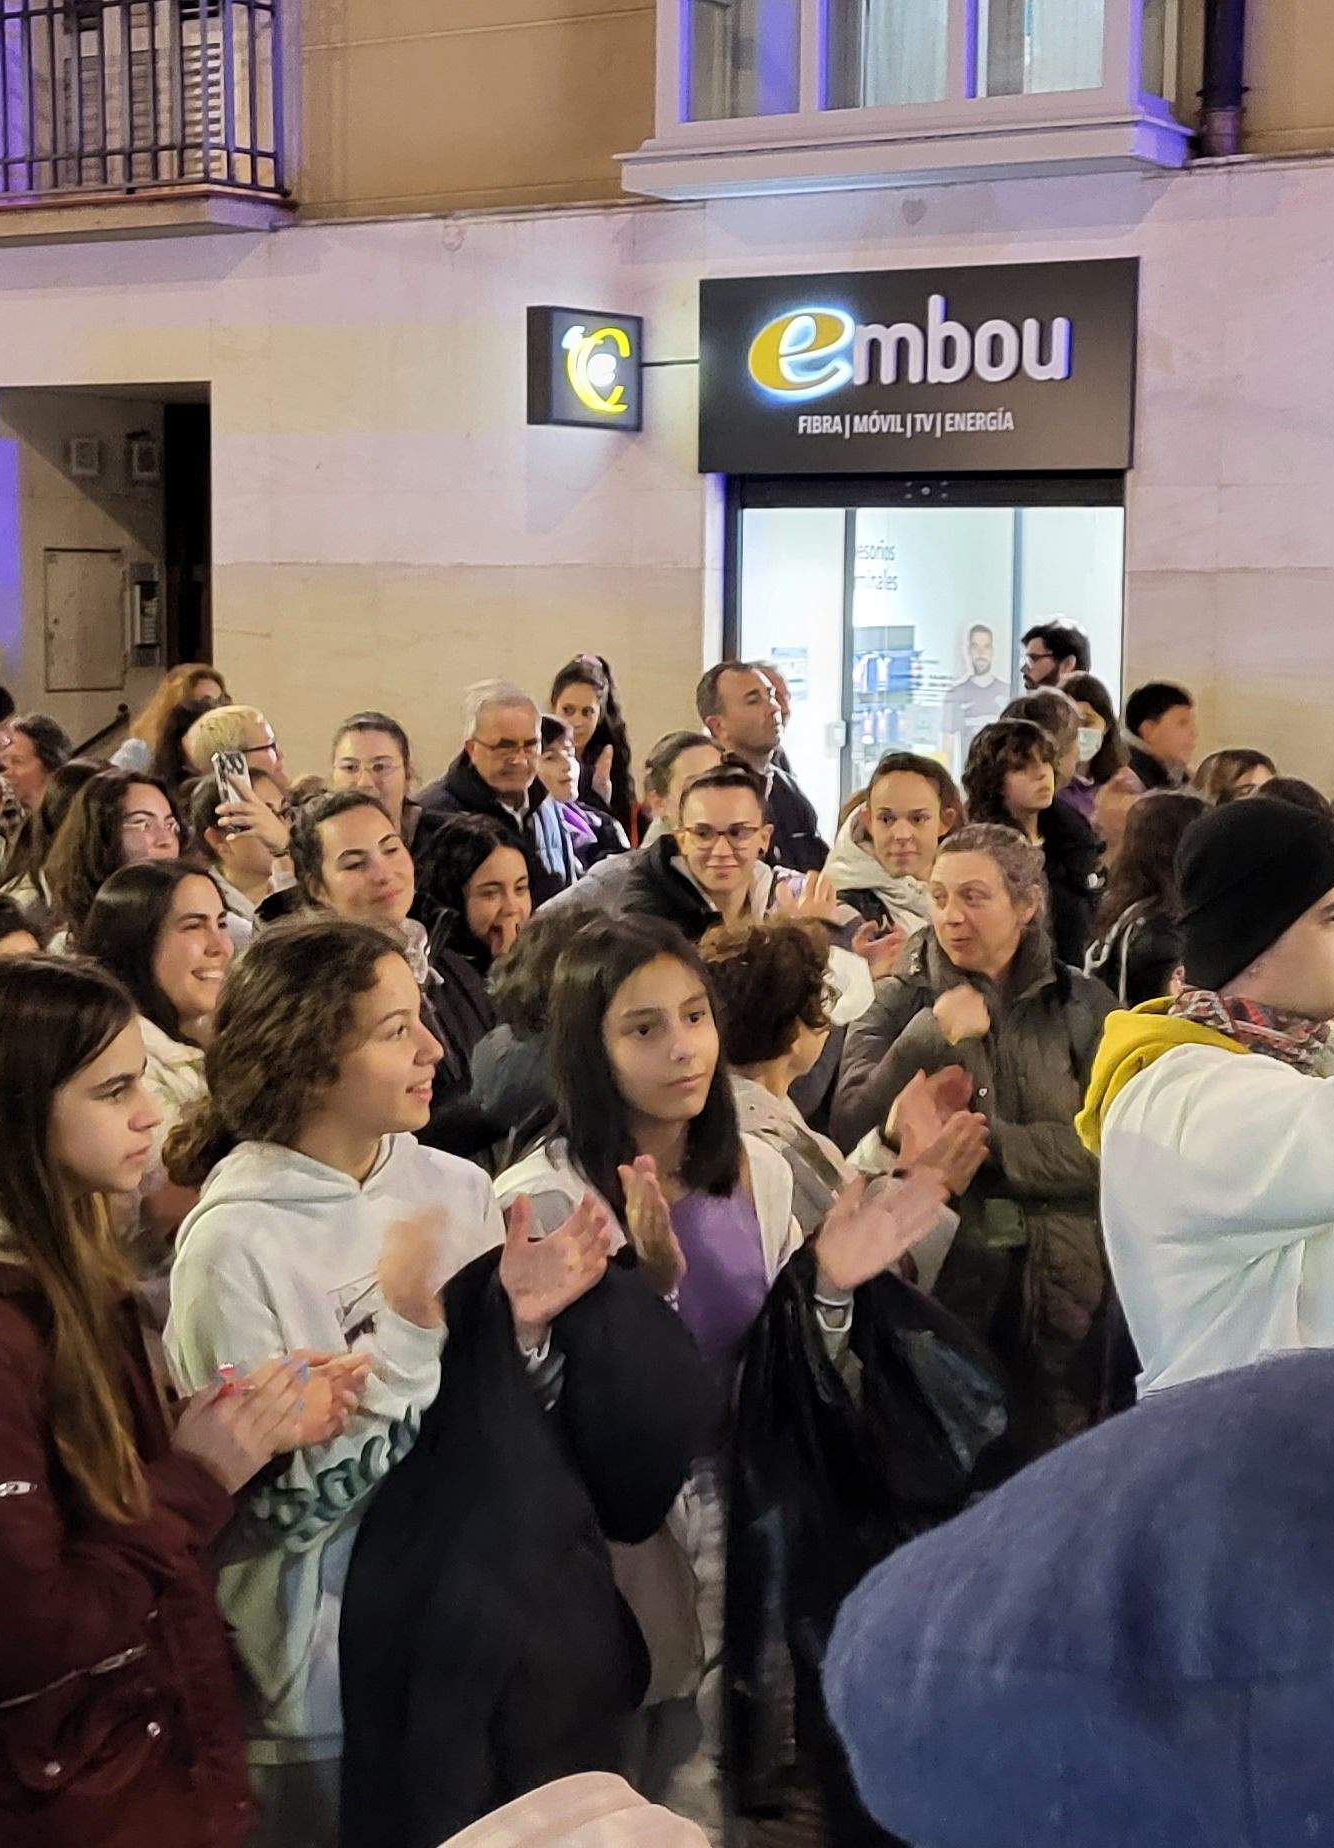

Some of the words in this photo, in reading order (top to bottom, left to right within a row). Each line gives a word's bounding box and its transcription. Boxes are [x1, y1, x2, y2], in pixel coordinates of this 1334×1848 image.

[748, 293, 1072, 400] embou
[797, 414, 843, 435] FIBRA
[852, 409, 905, 434] MÓVIL
[913, 413, 935, 433] TV
[944, 406, 1015, 432] ENERGÍA
